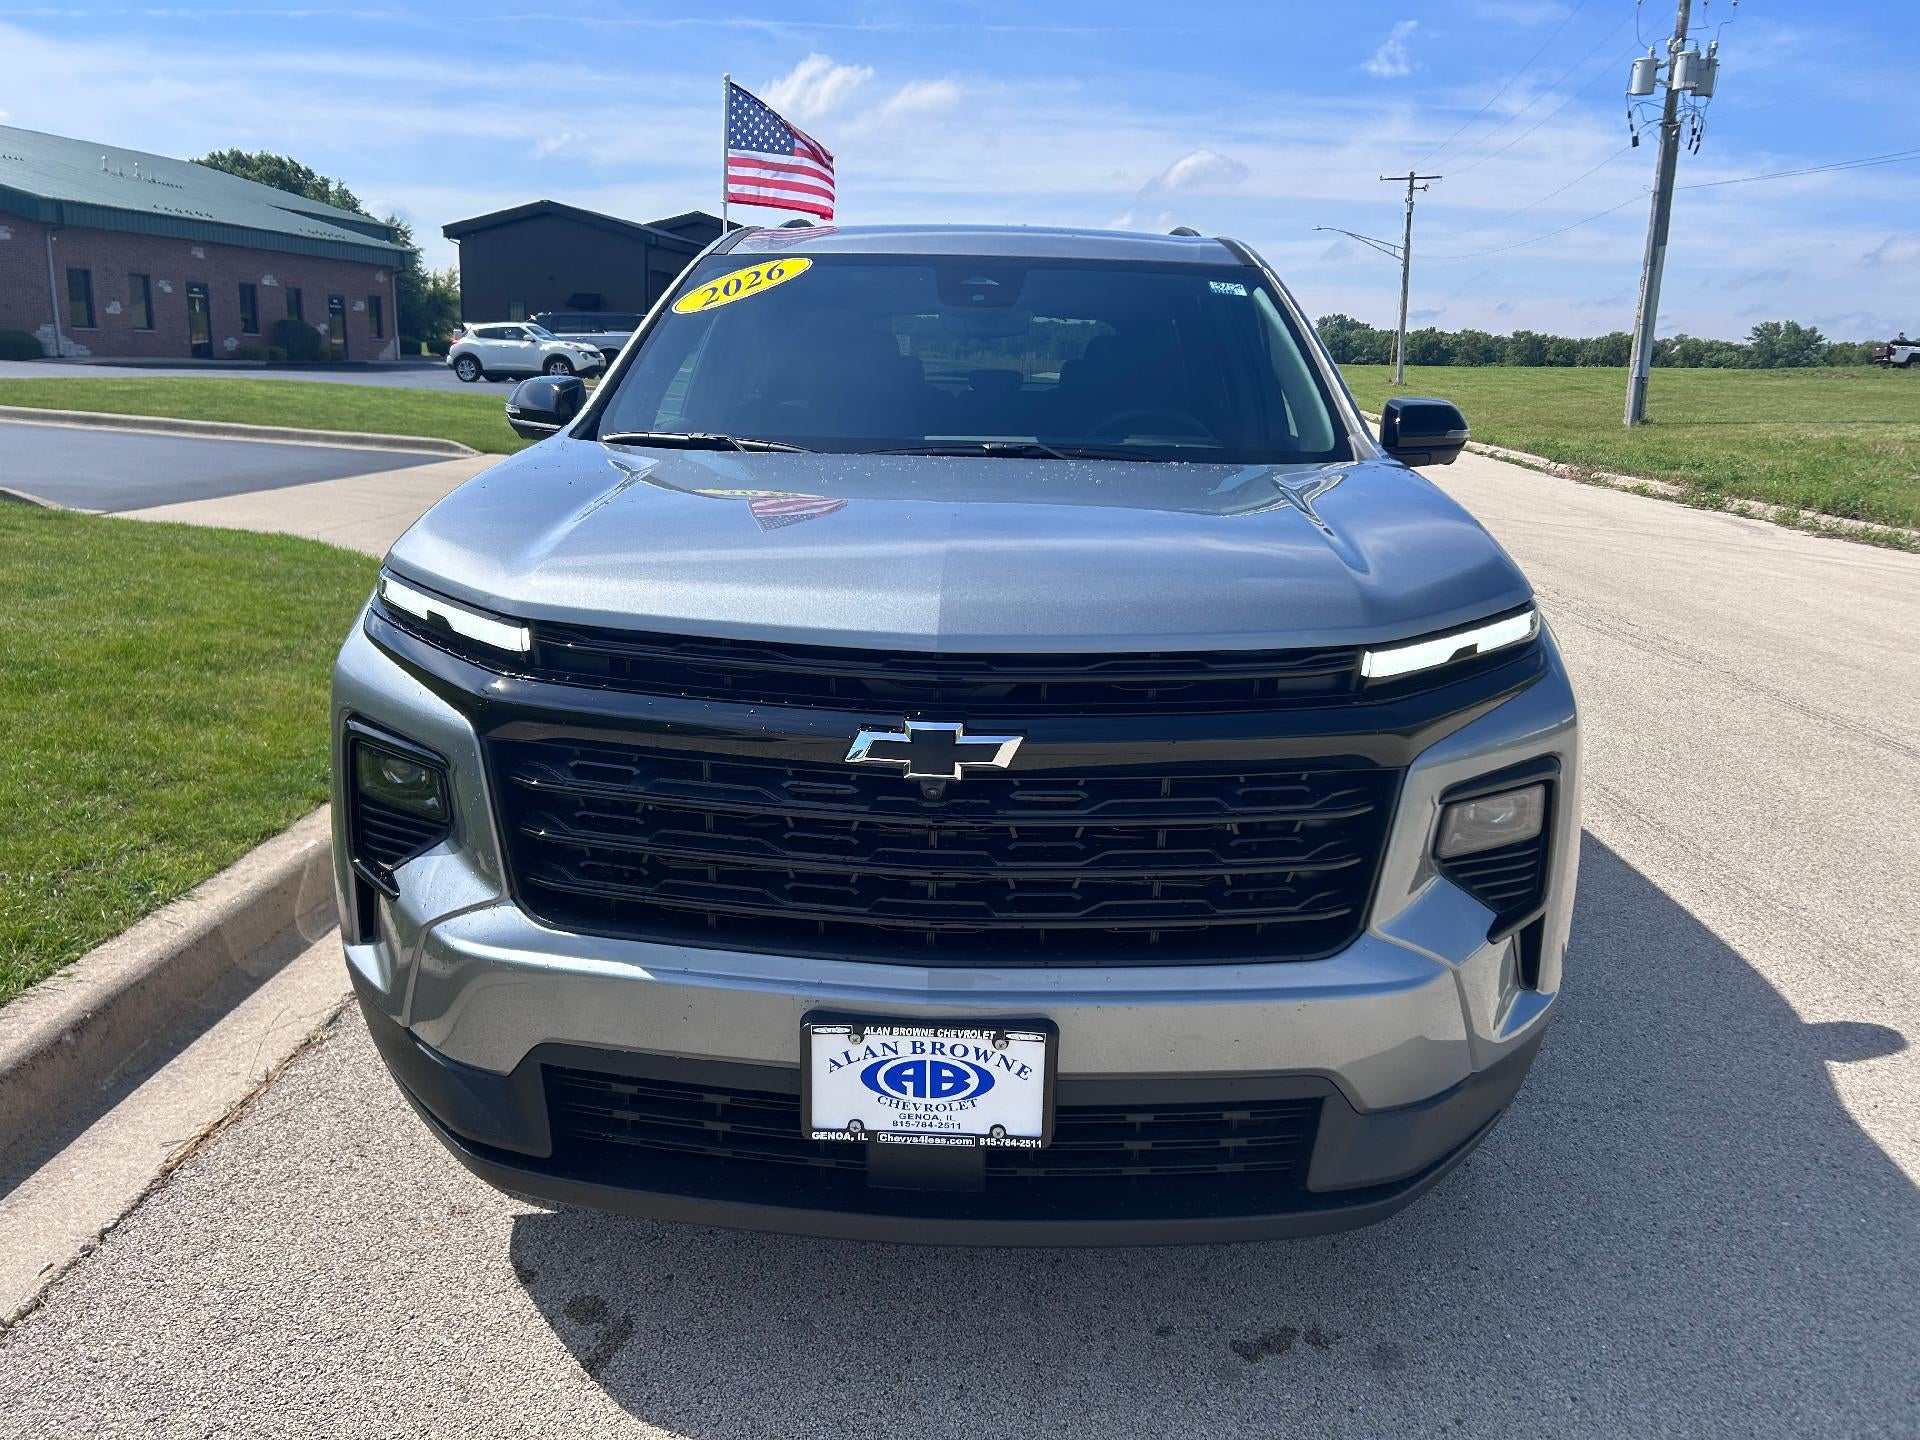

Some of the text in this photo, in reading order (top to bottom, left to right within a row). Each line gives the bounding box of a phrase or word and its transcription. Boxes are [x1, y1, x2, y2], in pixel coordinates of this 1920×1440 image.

[701, 261, 785, 307] 2026
[863, 1026, 997, 1040] ALAN BROWNE CHEVROLET
[828, 1040, 1033, 1081] ALAN BROWNE
[877, 1095, 978, 1113] CHEVROLET
[898, 1113, 956, 1122] GENOA, IL
[892, 1120, 961, 1130] 815-784-2511
[811, 1131, 869, 1142] GENOA, IL
[979, 1137, 1042, 1149] 815-784-2511
